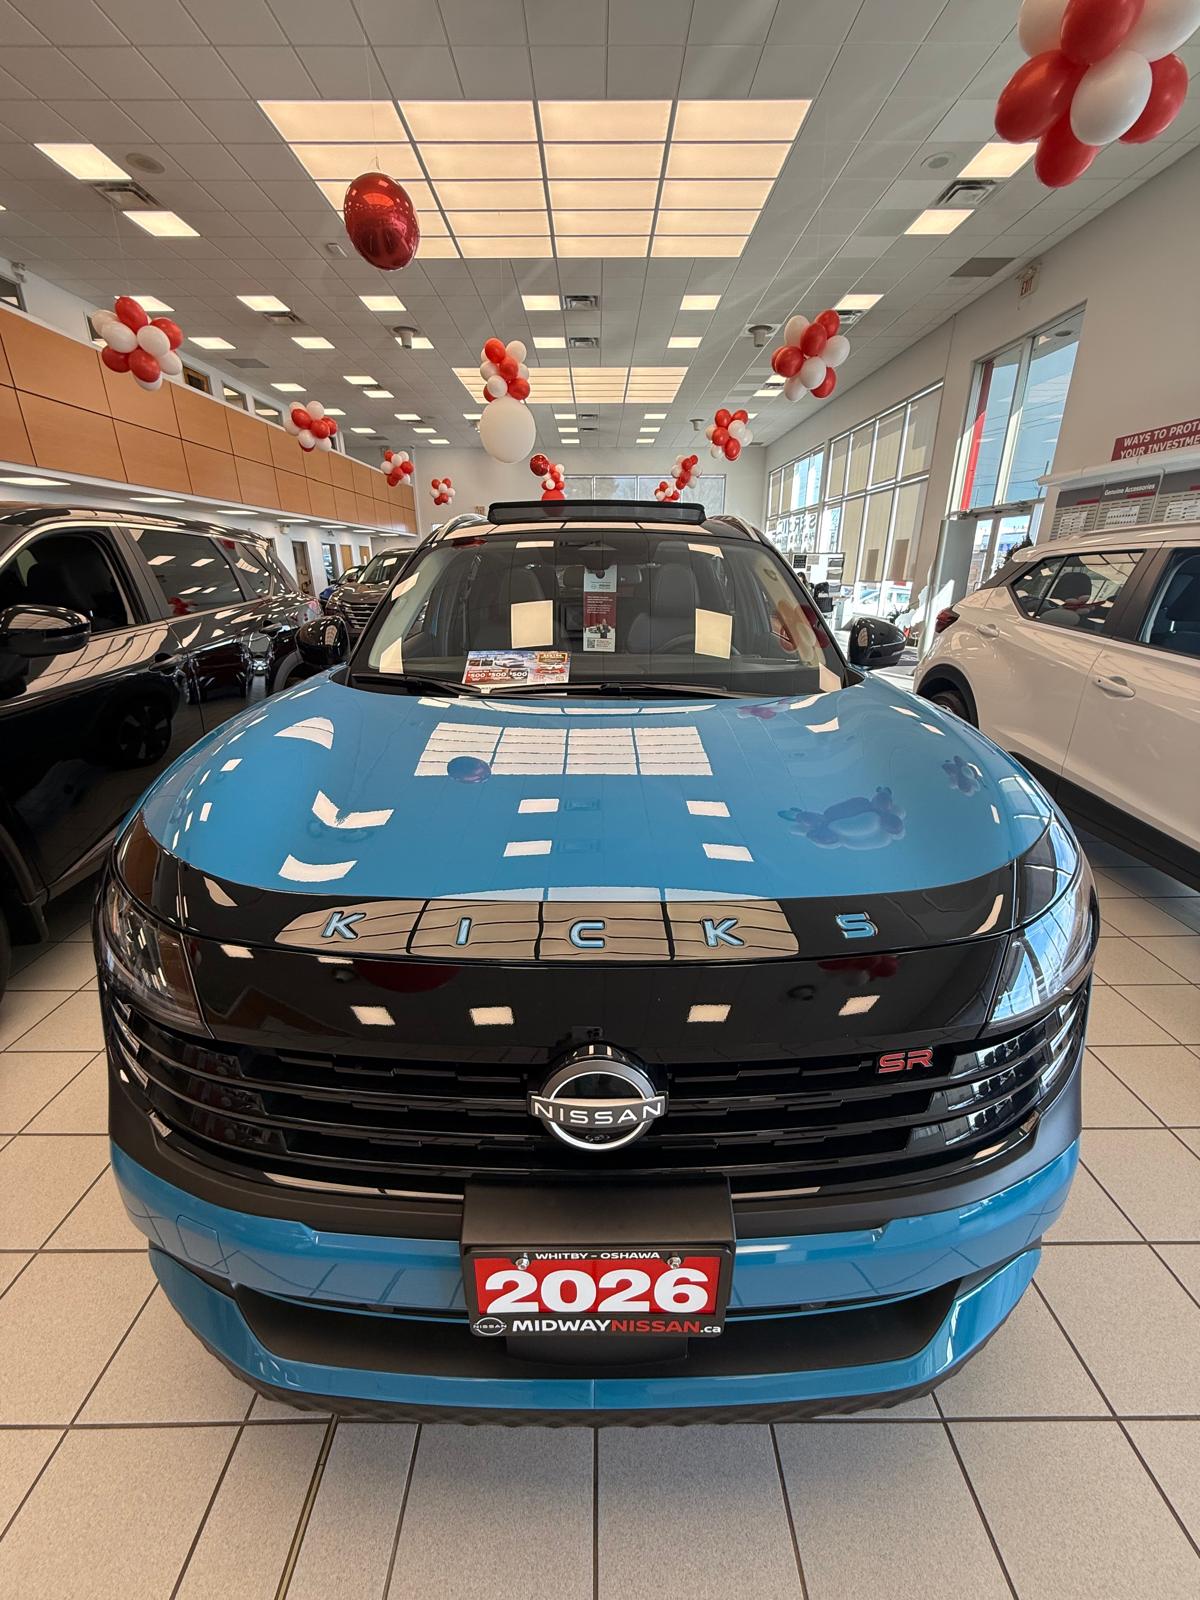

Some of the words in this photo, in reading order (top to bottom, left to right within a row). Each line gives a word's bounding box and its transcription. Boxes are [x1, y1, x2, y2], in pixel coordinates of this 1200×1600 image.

[1124, 432, 1151, 447] WAYS
[1153, 428, 1167, 440] TO
[1120, 446, 1146, 459] YOUR
[1104, 487, 1124, 496] Genuine
[1125, 483, 1156, 494] Accessories
[322, 910, 877, 949] KICKS
[879, 1048, 934, 1074] SR
[534, 1102, 661, 1125] NISSAN
[535, 1252, 588, 1260] WHITBY
[600, 1251, 660, 1260] OSHAWA
[485, 1268, 709, 1314] 2026
[472, 1323, 508, 1331] NISSAN
[512, 1319, 722, 1334] MIDWAYNISSAN.ca
